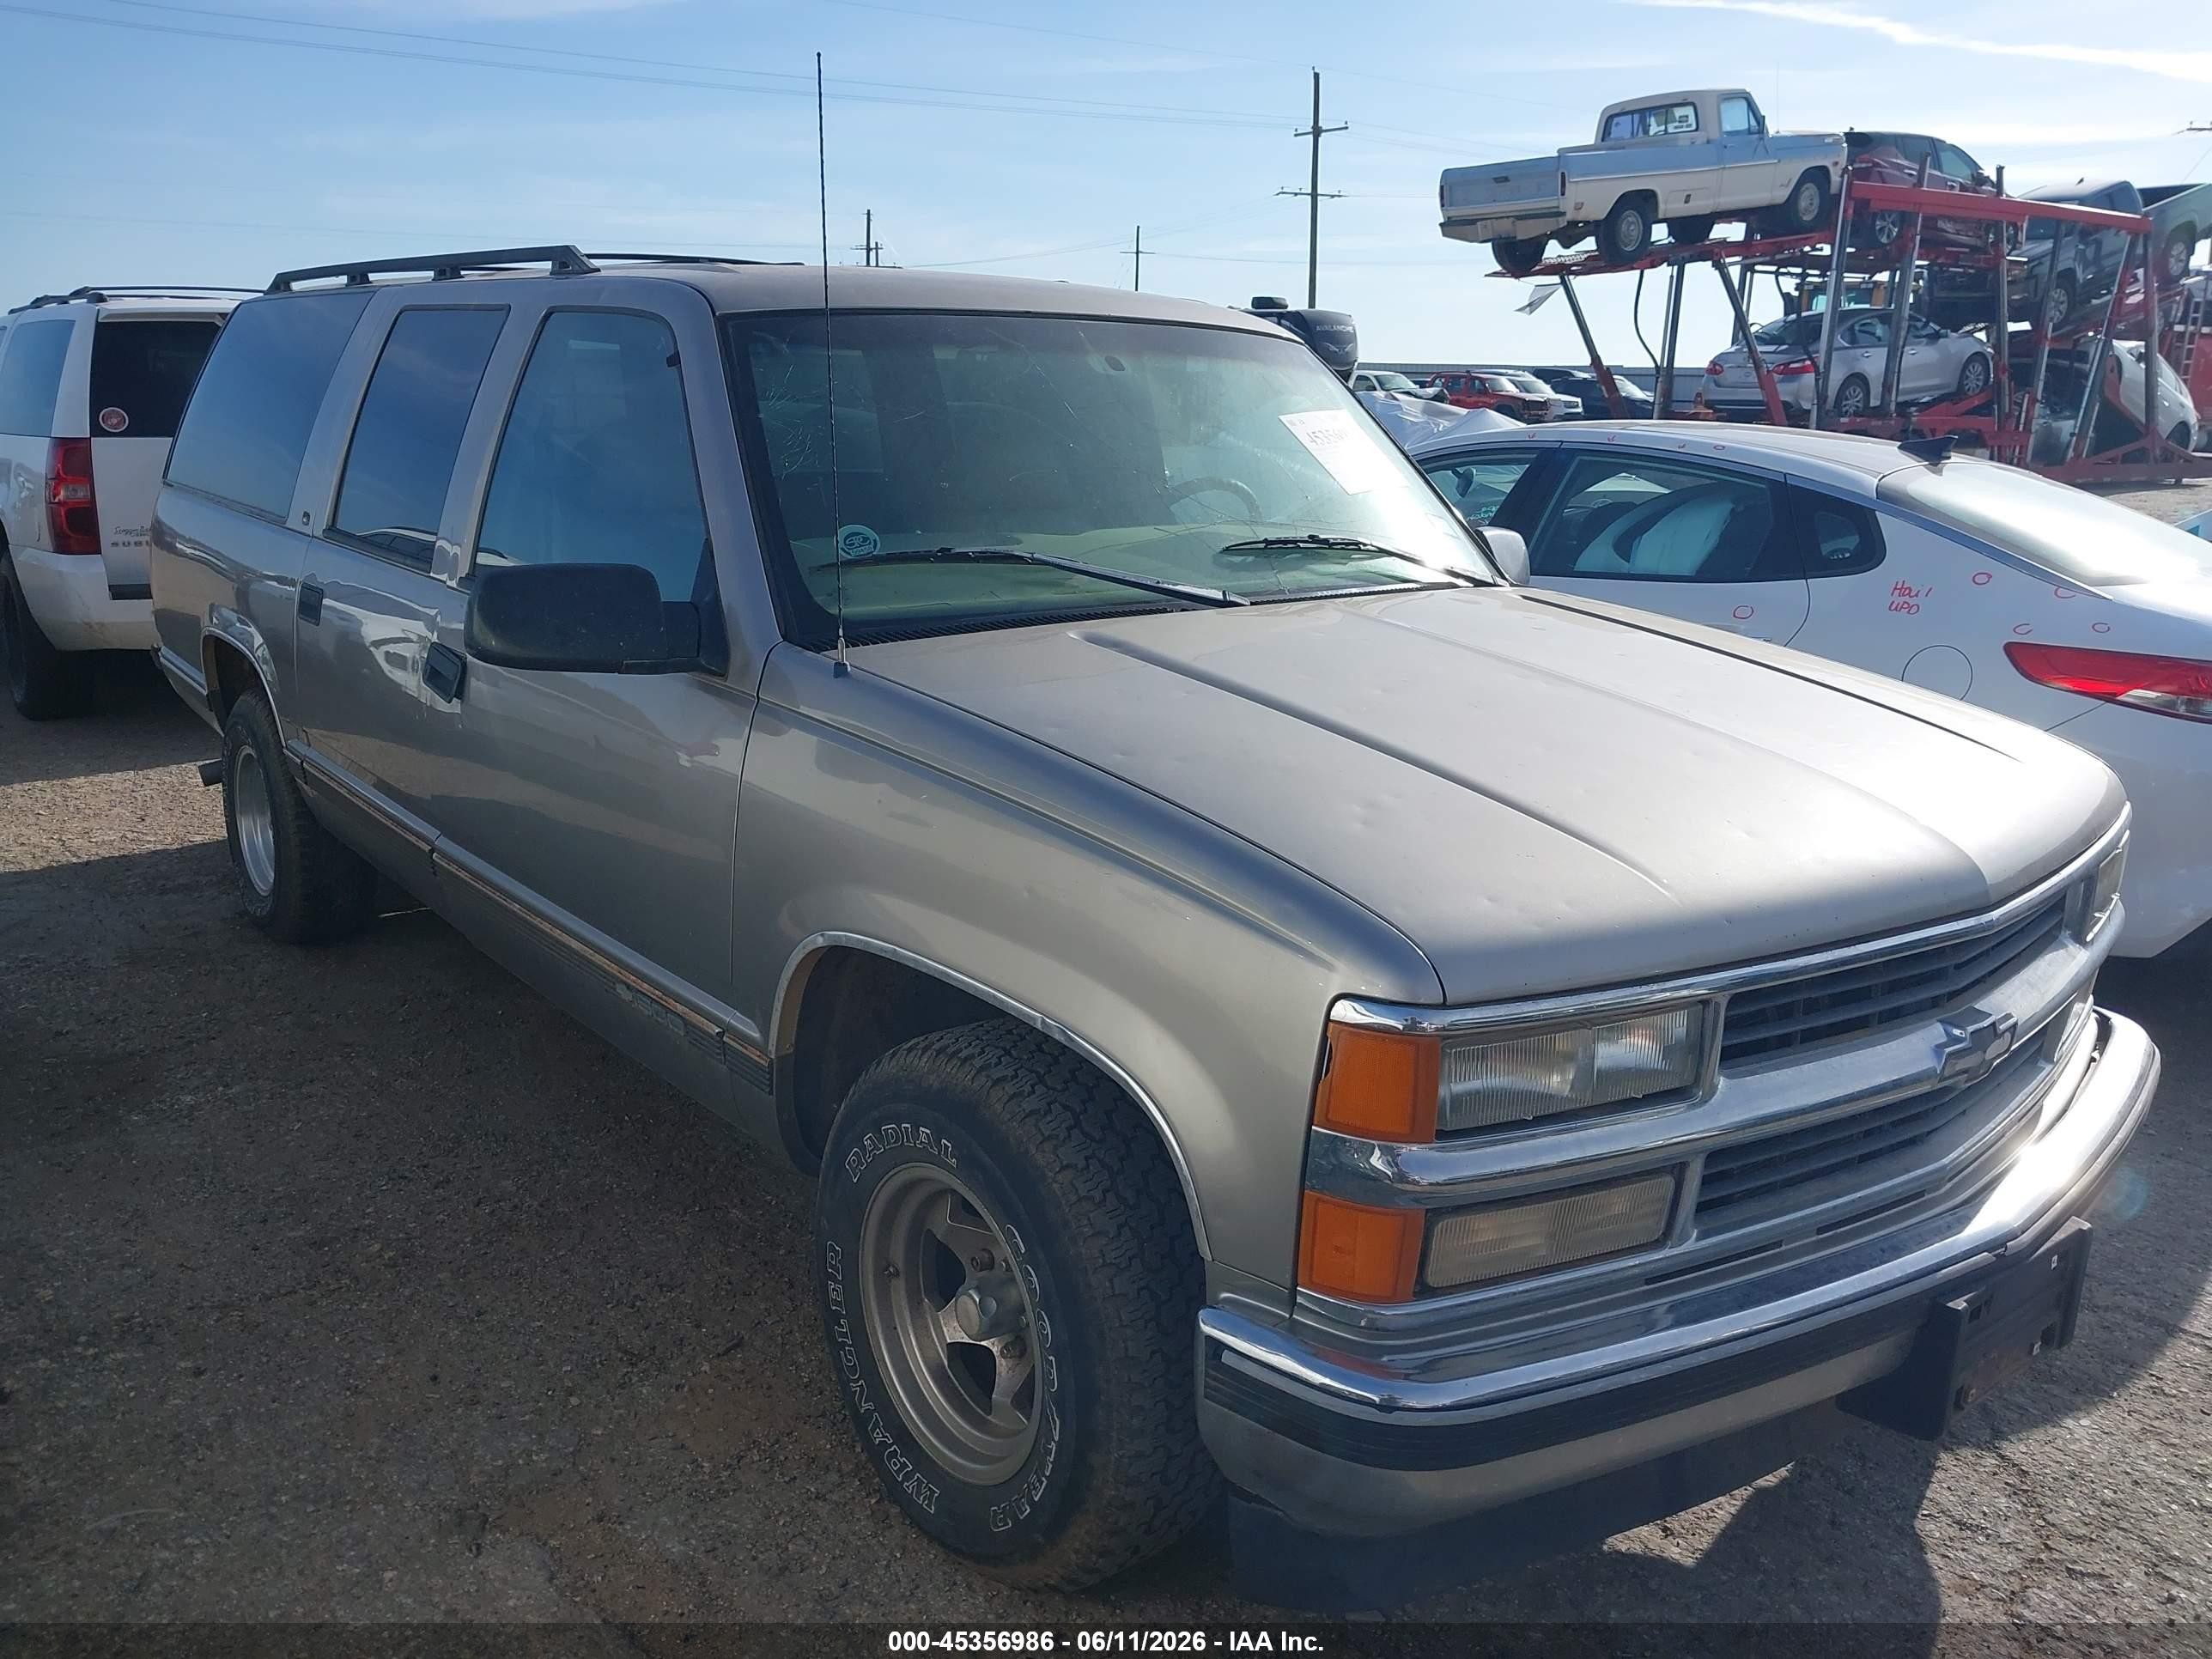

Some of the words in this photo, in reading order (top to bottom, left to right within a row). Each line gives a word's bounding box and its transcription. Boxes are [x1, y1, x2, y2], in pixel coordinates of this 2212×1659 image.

[1890, 580, 1933, 599] Hail
[845, 1123, 957, 1183] RADIAL
[826, 1242, 941, 1514] WRANGLER
[990, 1224, 1060, 1532] GOODYEAR
